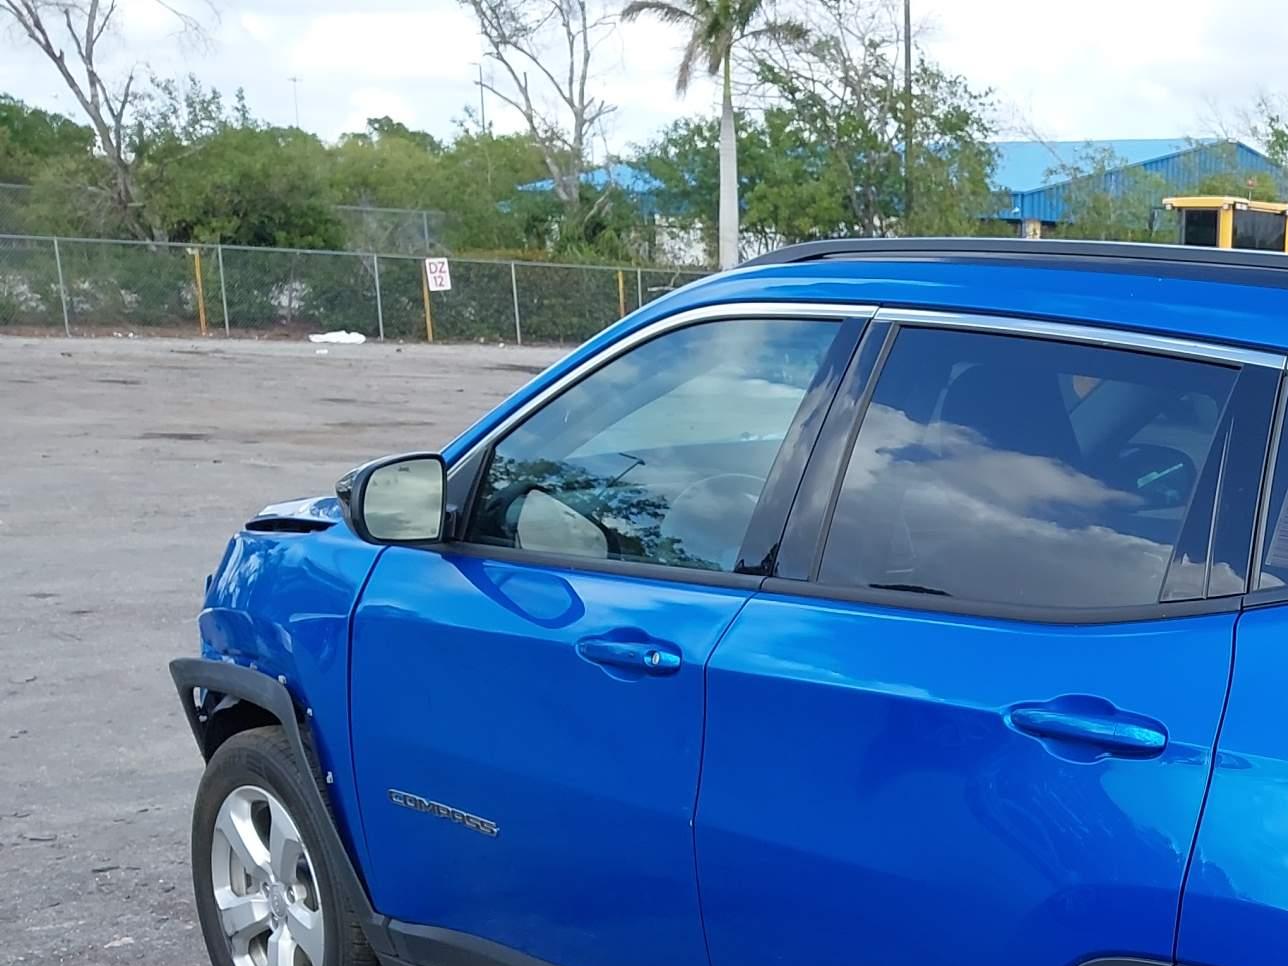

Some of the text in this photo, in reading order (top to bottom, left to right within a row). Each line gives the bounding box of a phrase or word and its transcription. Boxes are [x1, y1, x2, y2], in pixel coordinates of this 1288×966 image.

[429, 261, 447, 274] DZ
[433, 275, 446, 288] 12
[388, 788, 500, 838] COMPASS
